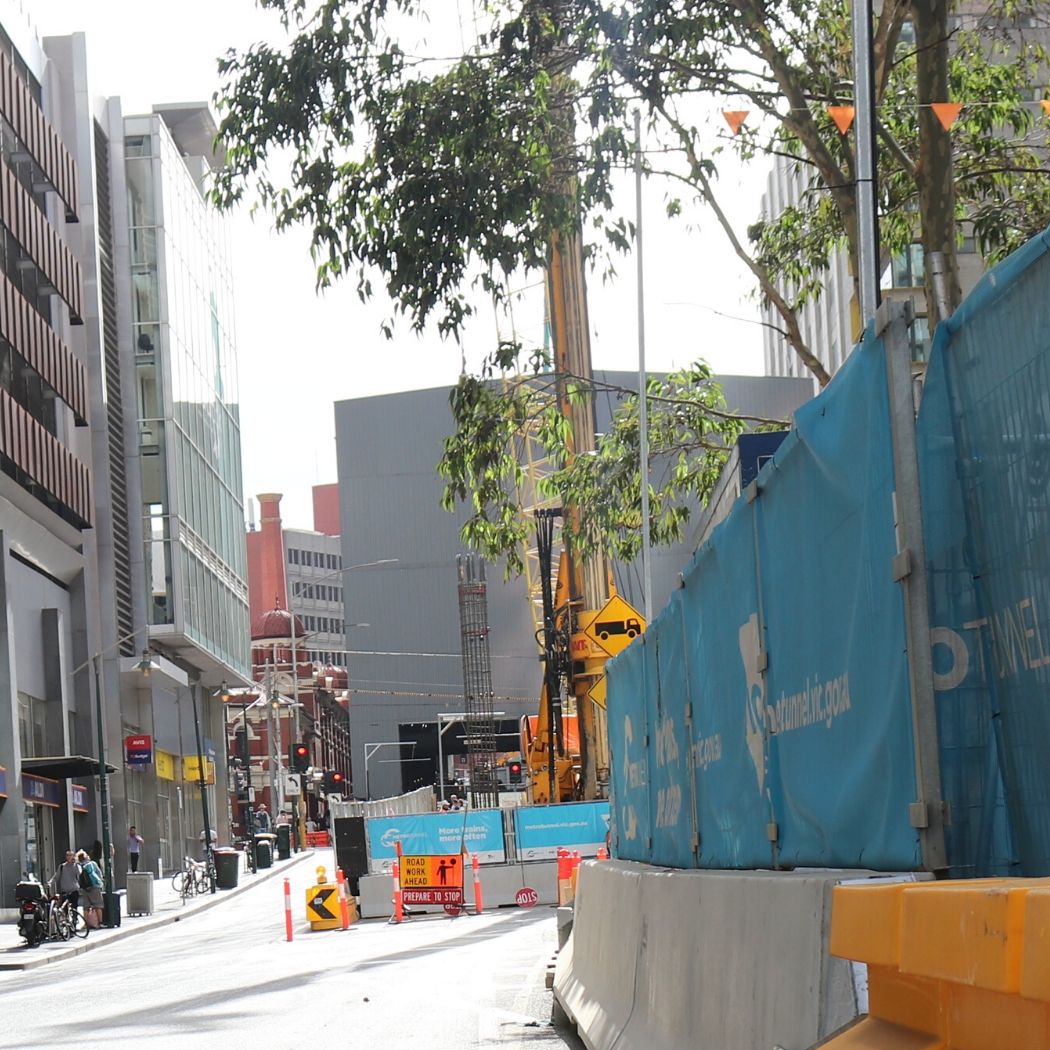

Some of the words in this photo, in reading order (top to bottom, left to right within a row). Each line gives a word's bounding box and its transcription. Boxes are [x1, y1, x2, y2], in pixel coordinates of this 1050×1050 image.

[438, 827, 460, 835] More
[439, 834, 461, 842] more
[463, 833, 486, 841] often
[406, 858, 425, 866] ROAD
[406, 868, 425, 876] WORK
[404, 877, 428, 885] AHEAD
[403, 891, 432, 902] PREPARE
[433, 891, 442, 901] TO
[445, 891, 460, 901] STOP
[517, 891, 538, 904] STOP
